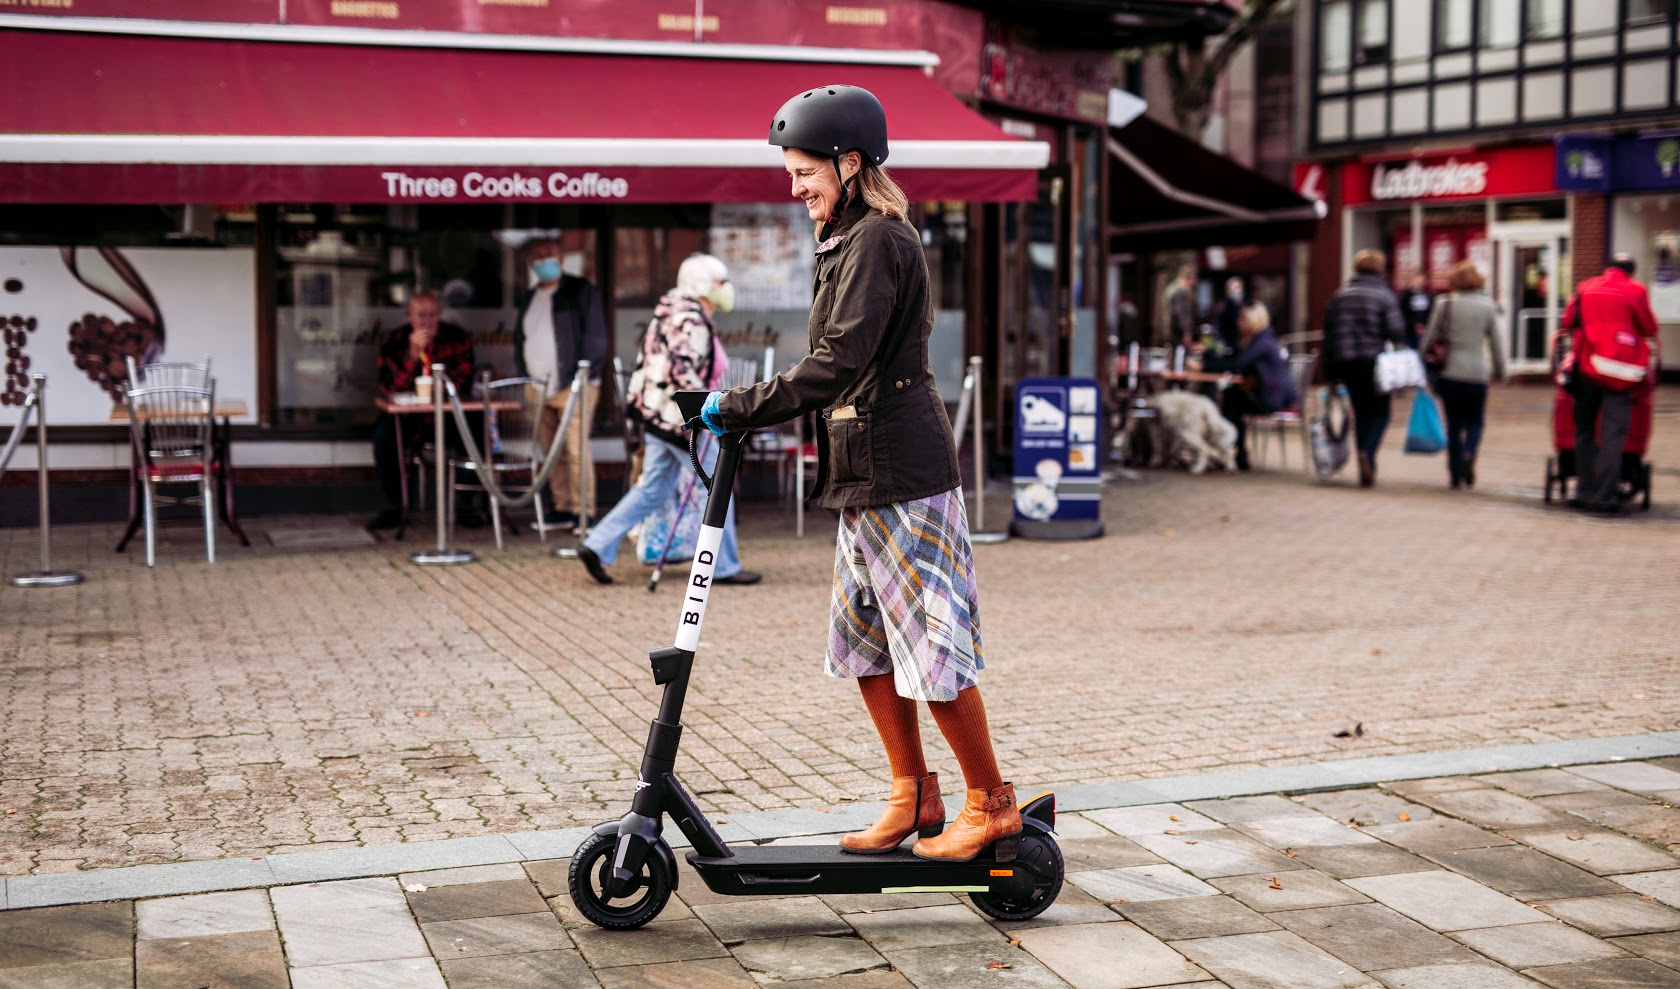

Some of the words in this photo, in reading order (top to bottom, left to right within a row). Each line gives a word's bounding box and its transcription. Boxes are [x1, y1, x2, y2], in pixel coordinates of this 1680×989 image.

[382, 172, 458, 197] Three
[462, 172, 543, 198] Cooks
[547, 172, 628, 198] Coffee
[1371, 157, 1489, 200] Ladbrokes
[683, 550, 714, 625] BIRD
